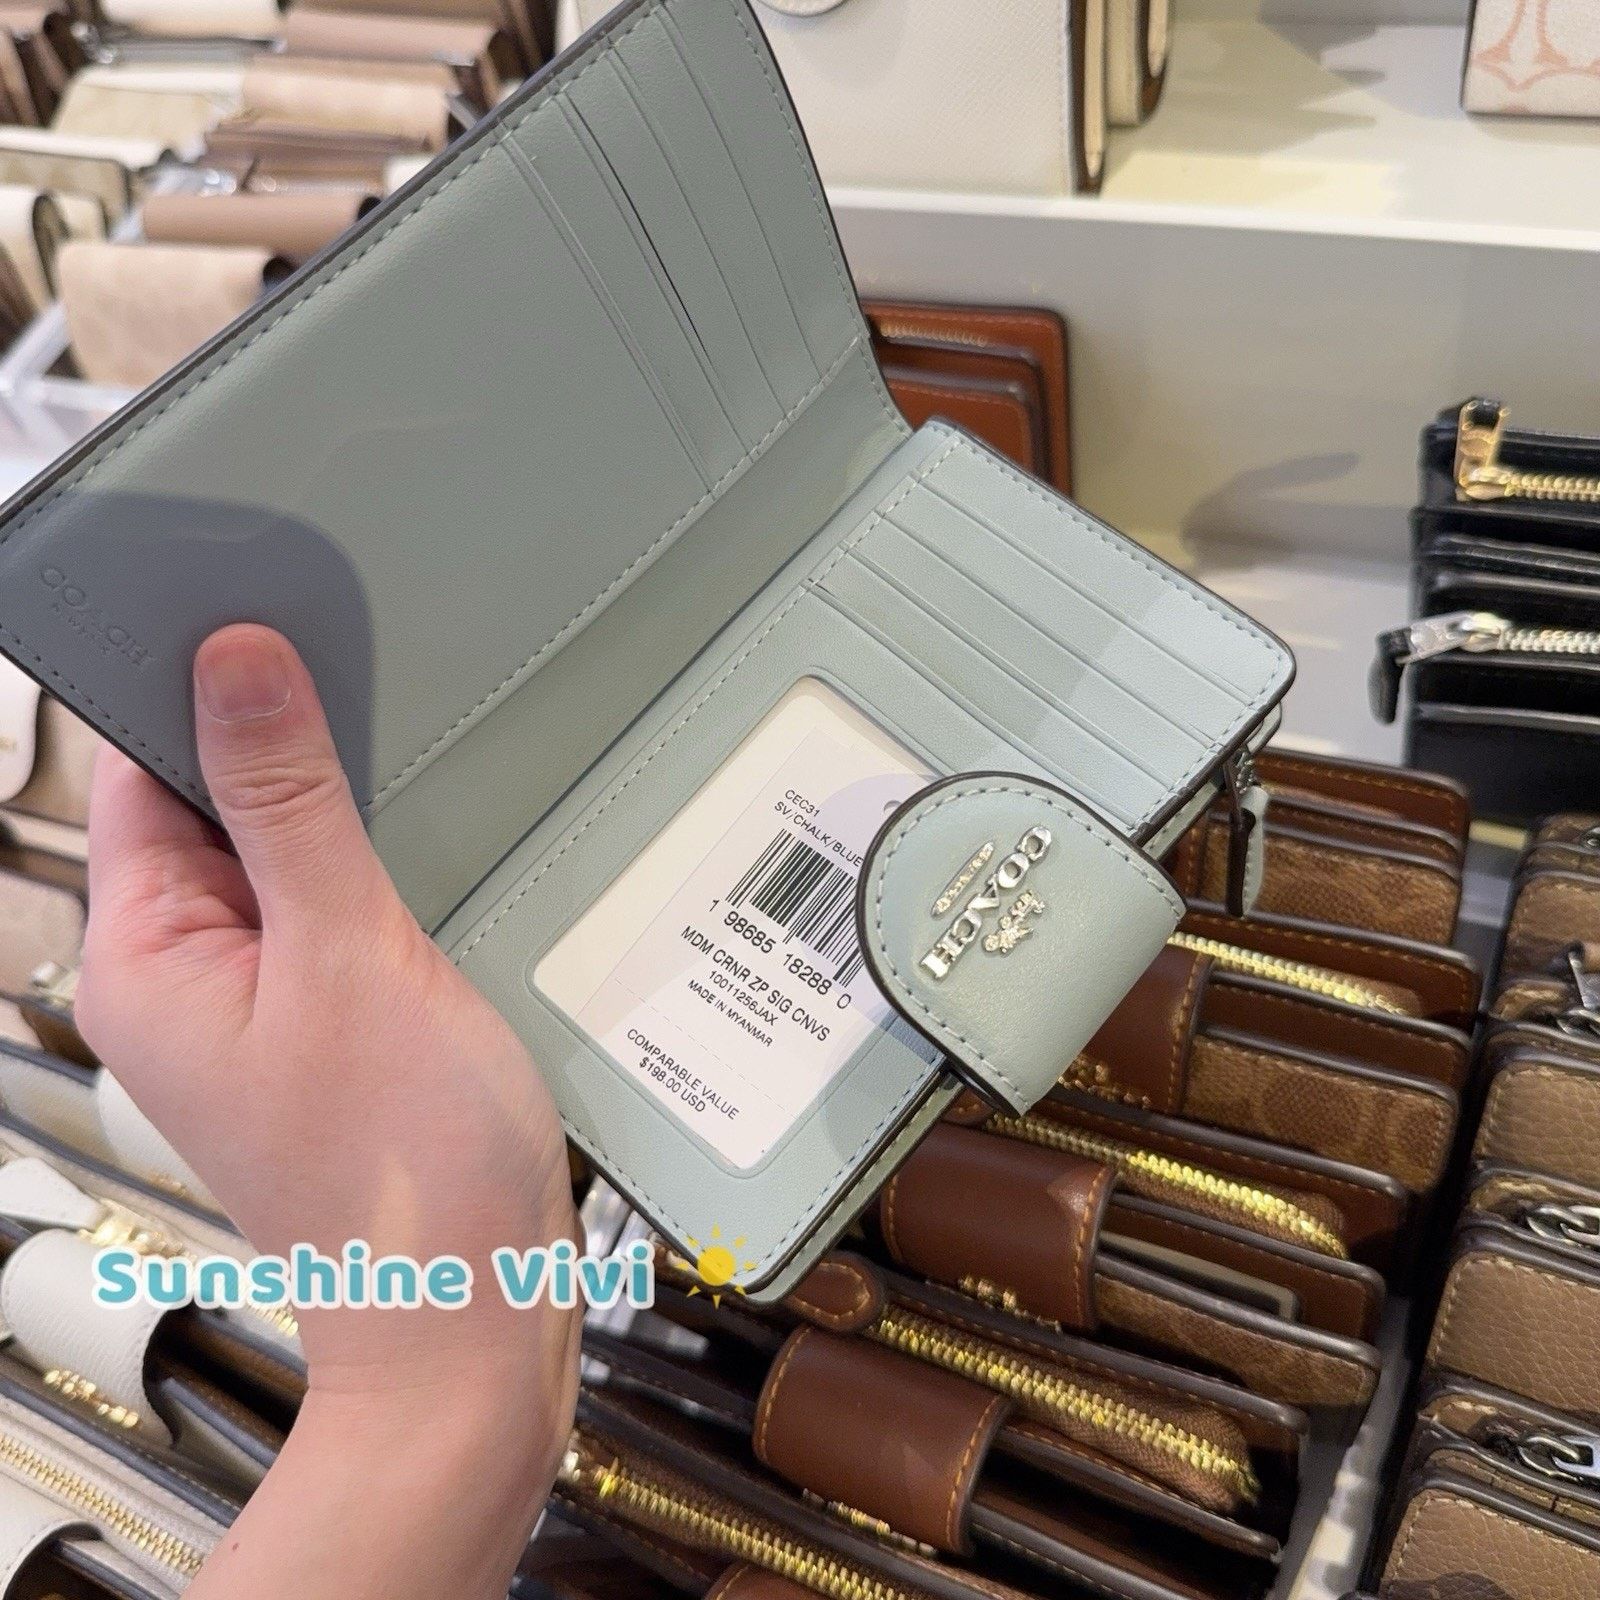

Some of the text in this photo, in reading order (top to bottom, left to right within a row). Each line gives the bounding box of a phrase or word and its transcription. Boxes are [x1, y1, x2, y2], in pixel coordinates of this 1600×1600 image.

[774, 801, 863, 868] SV/CHALK/BLUE
[784, 788, 820, 818] CEC31
[919, 826, 1052, 979] COACH
[681, 925, 831, 1042] MDM CRNR ZP SIG CNVS
[709, 898, 852, 1010] 1 98685 18288 0
[688, 979, 773, 1048] MADE IN MYANMAR
[708, 970, 779, 1027] 10011256JAX
[627, 1028, 740, 1121] COMPARABLE VALUE
[639, 1056, 706, 1114] $198.00 USD
